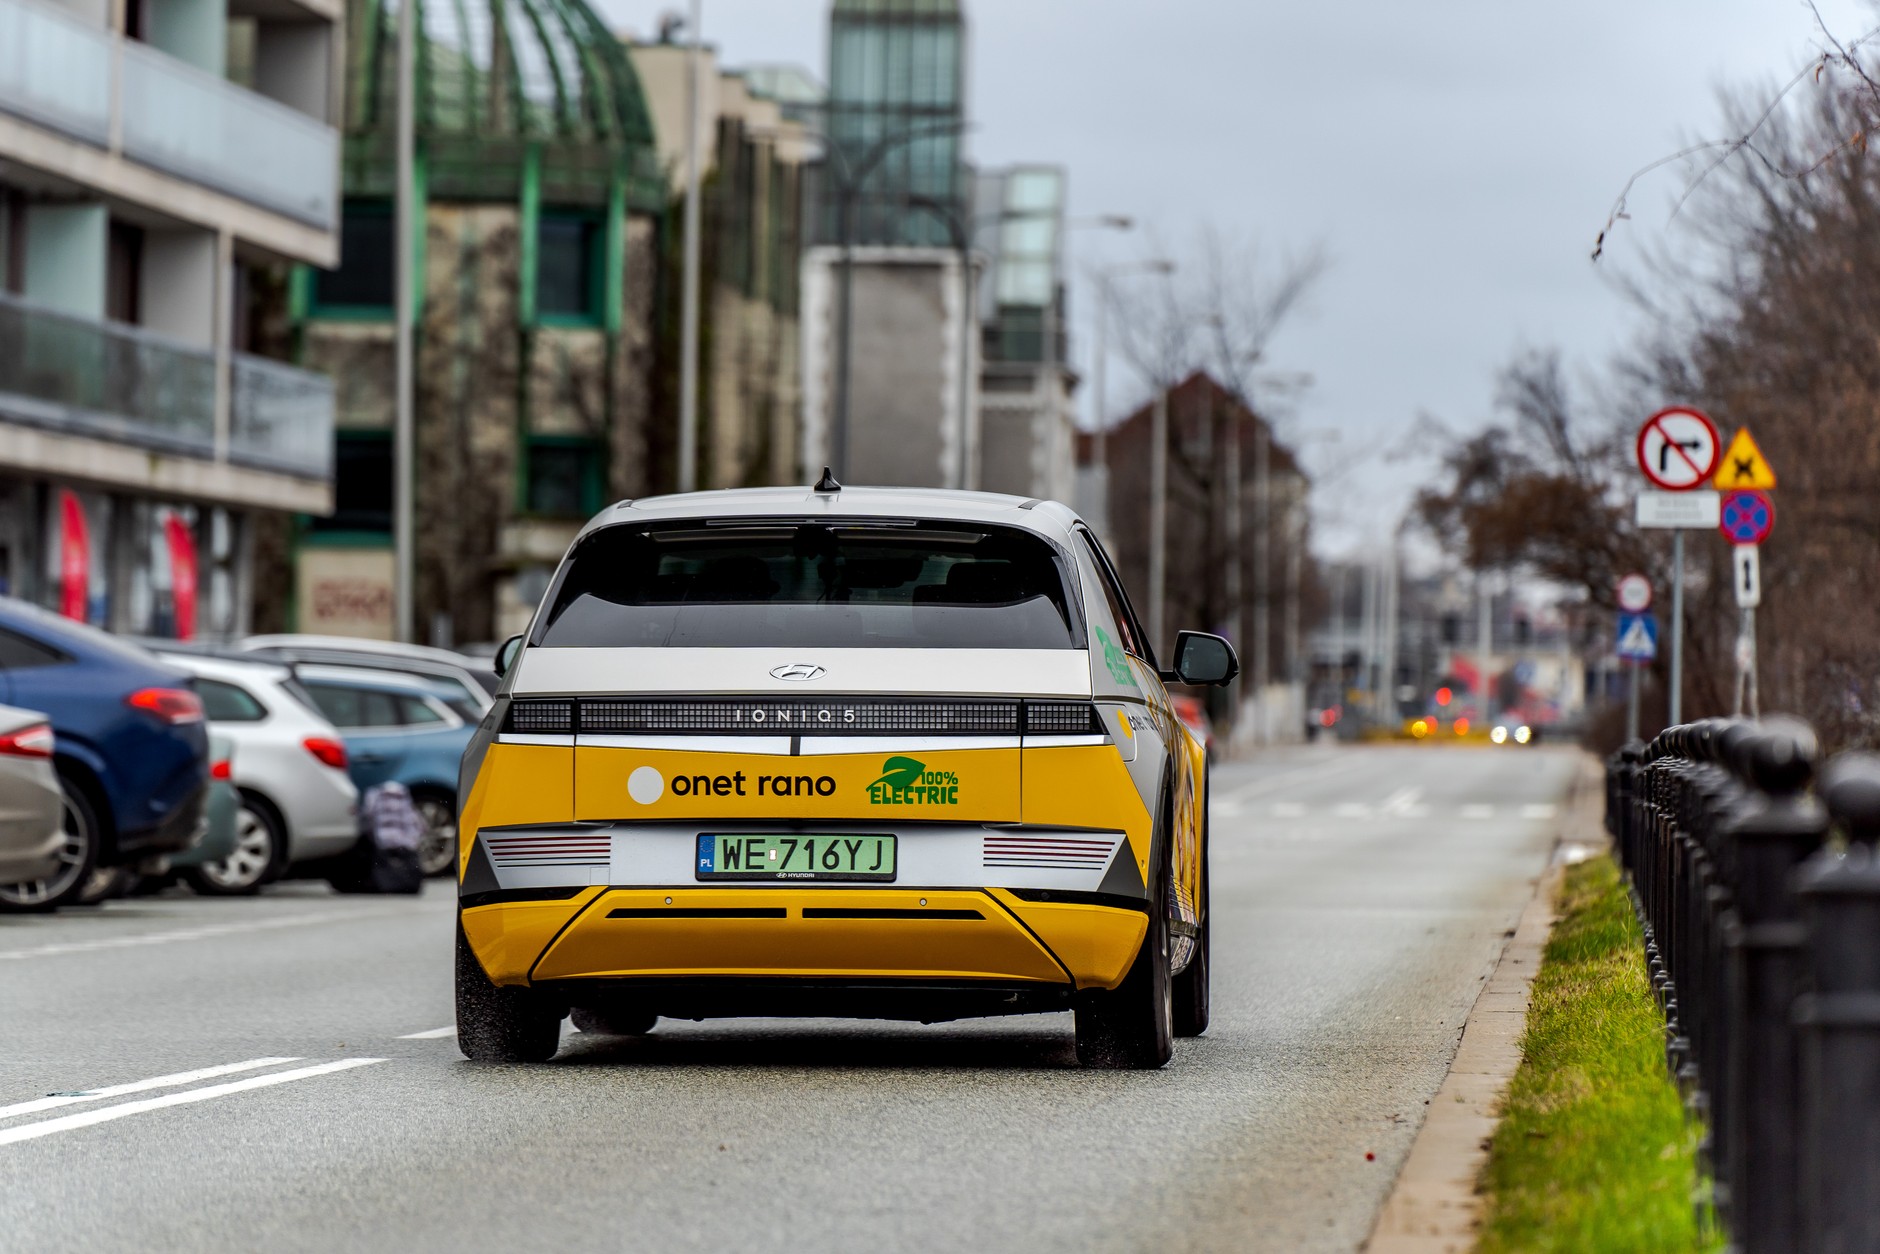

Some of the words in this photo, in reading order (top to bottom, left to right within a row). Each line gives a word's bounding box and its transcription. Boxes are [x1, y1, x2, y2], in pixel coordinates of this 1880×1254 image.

[671, 770, 746, 797] onet
[758, 774, 837, 797] rano
[919, 771, 959, 786] 100%
[870, 784, 959, 805] ELECTRIC
[700, 858, 713, 868] PL
[722, 838, 766, 870] WE
[779, 839, 883, 871] 716YJ
